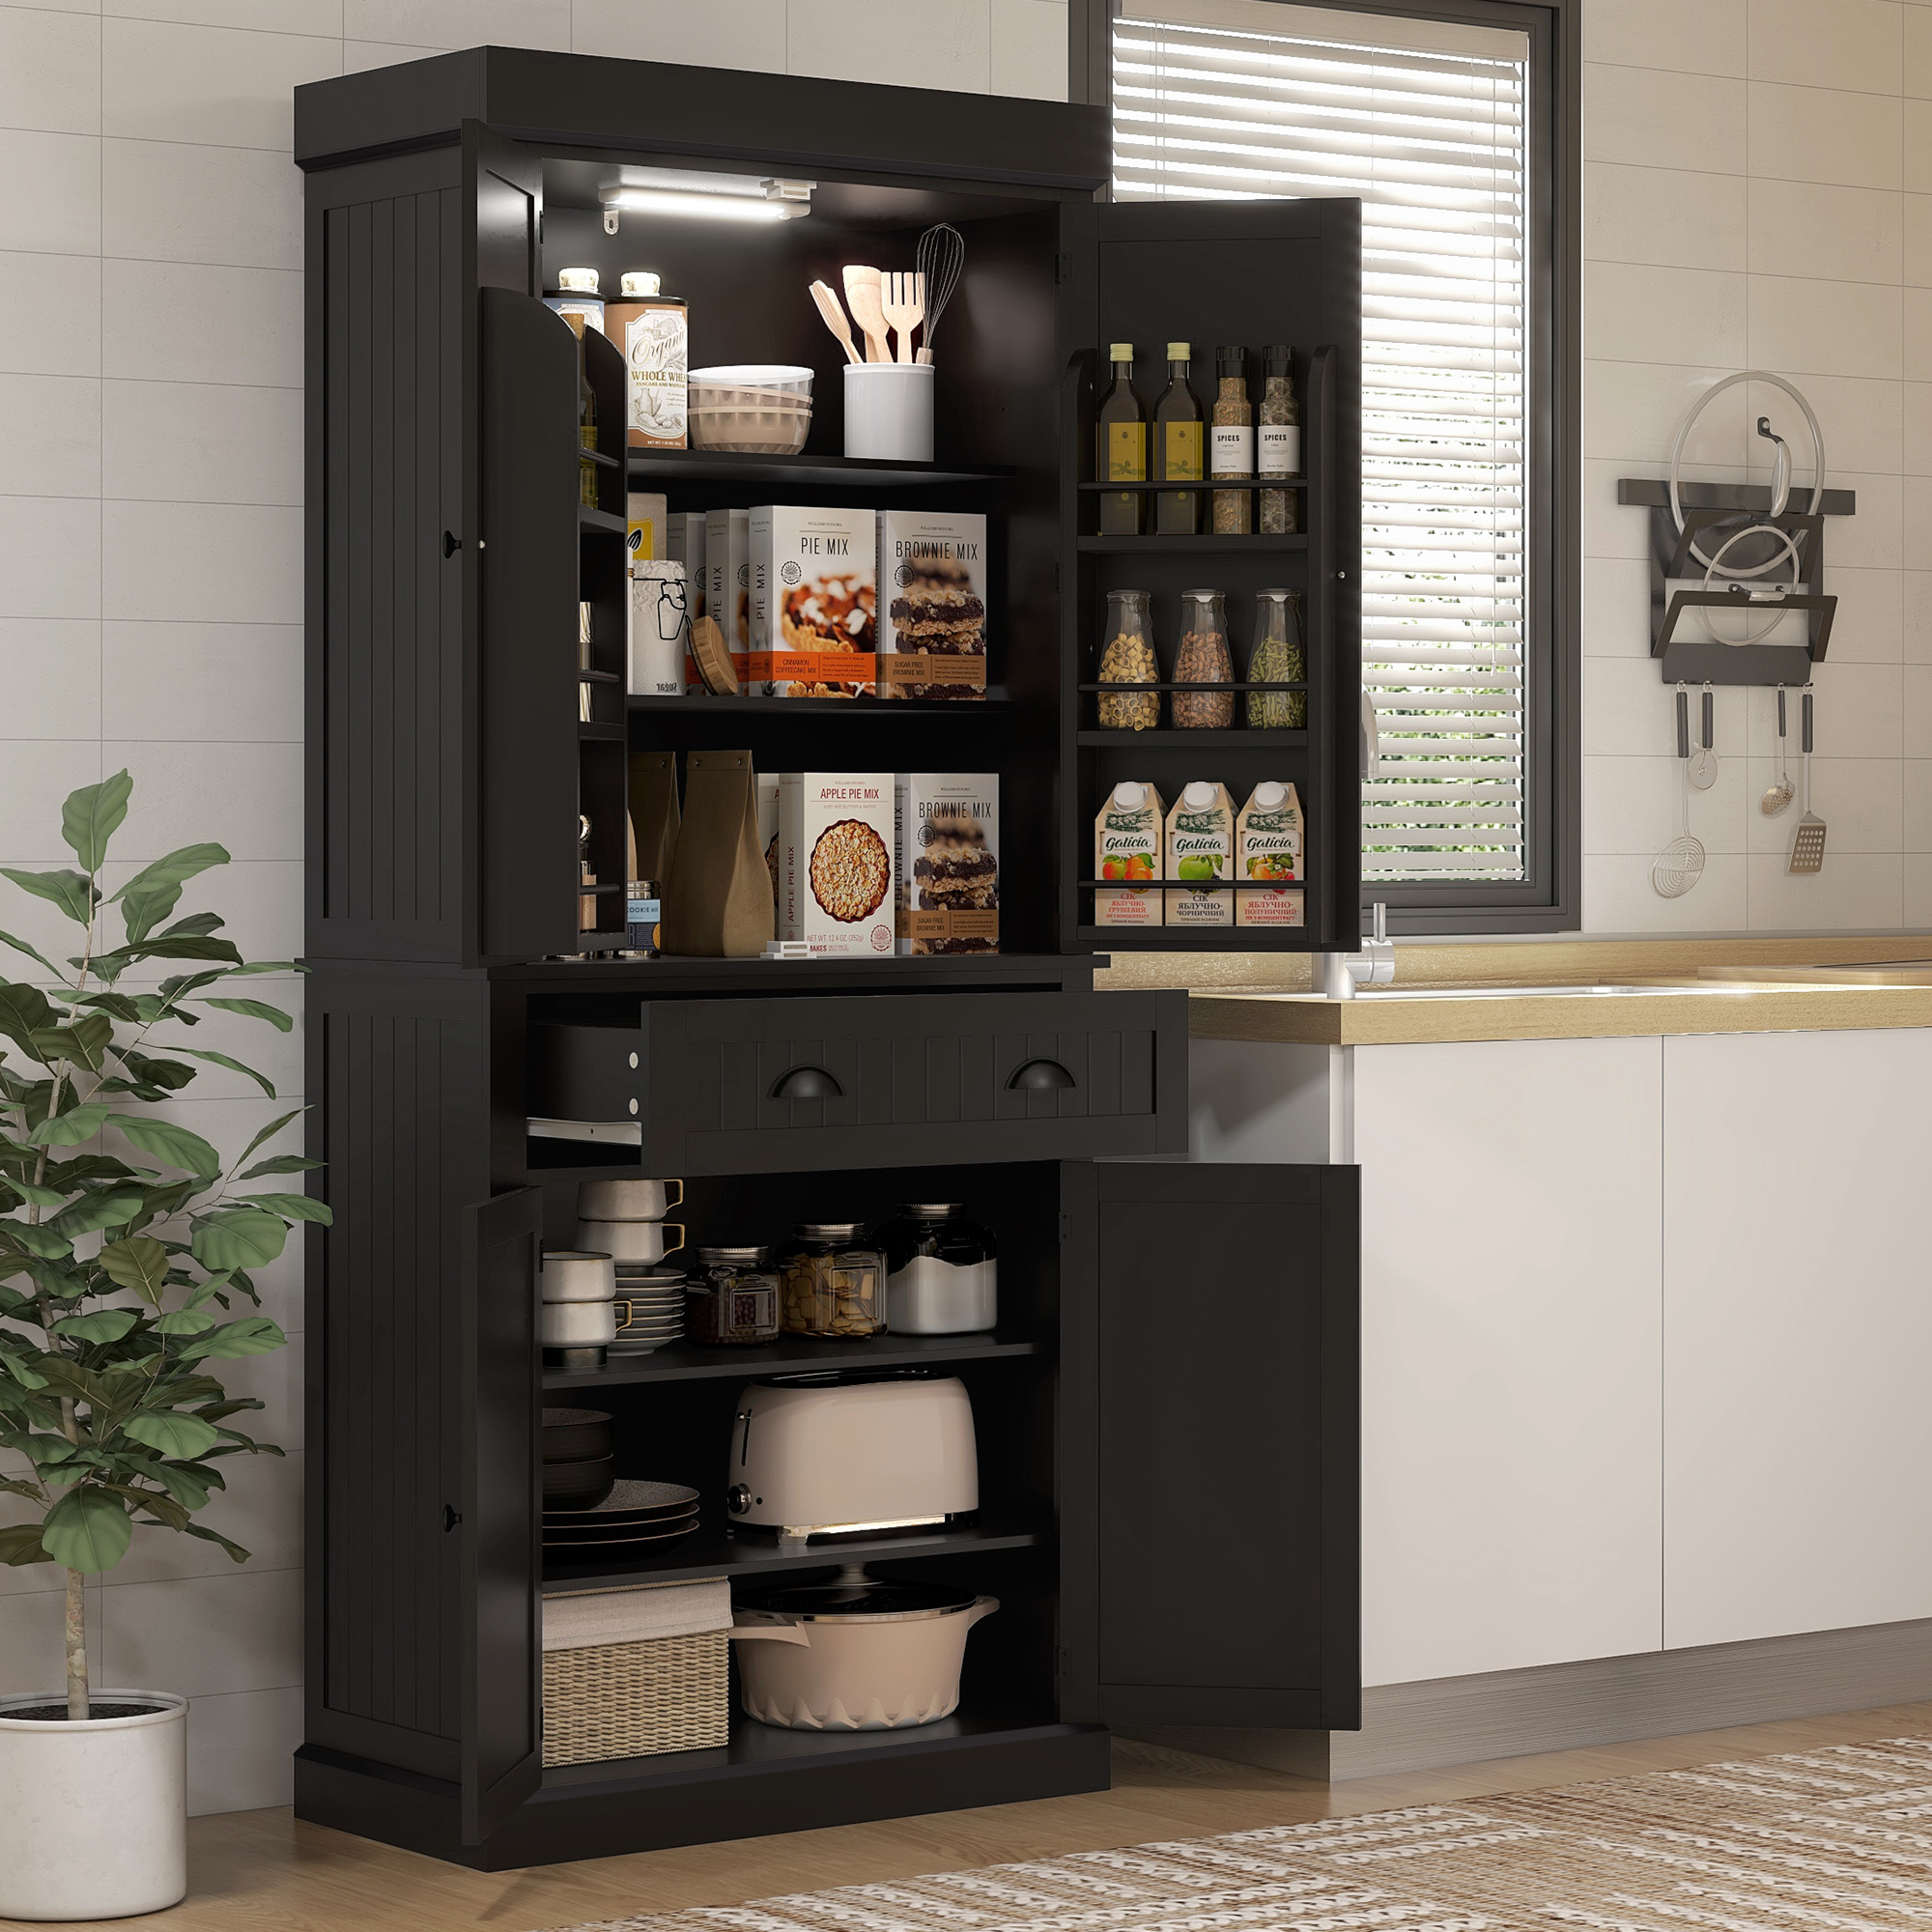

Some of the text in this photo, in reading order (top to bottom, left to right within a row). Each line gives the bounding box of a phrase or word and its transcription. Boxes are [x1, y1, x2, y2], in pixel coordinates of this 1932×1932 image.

[631, 370, 686, 384] WHOLE WHEA
[801, 537, 849, 555] PIE MIX
[895, 541, 979, 560] BROWNIE MIX
[756, 564, 765, 619] PIE MIX
[820, 788, 880, 799] APPLE PIE MIX
[919, 802, 991, 818] BROWNIE MIX
[1105, 837, 1152, 851] Galicia
[1176, 838, 1225, 853] Galicia
[1246, 836, 1295, 851] Galicia
[895, 807, 903, 901] BROWNIE MIX
